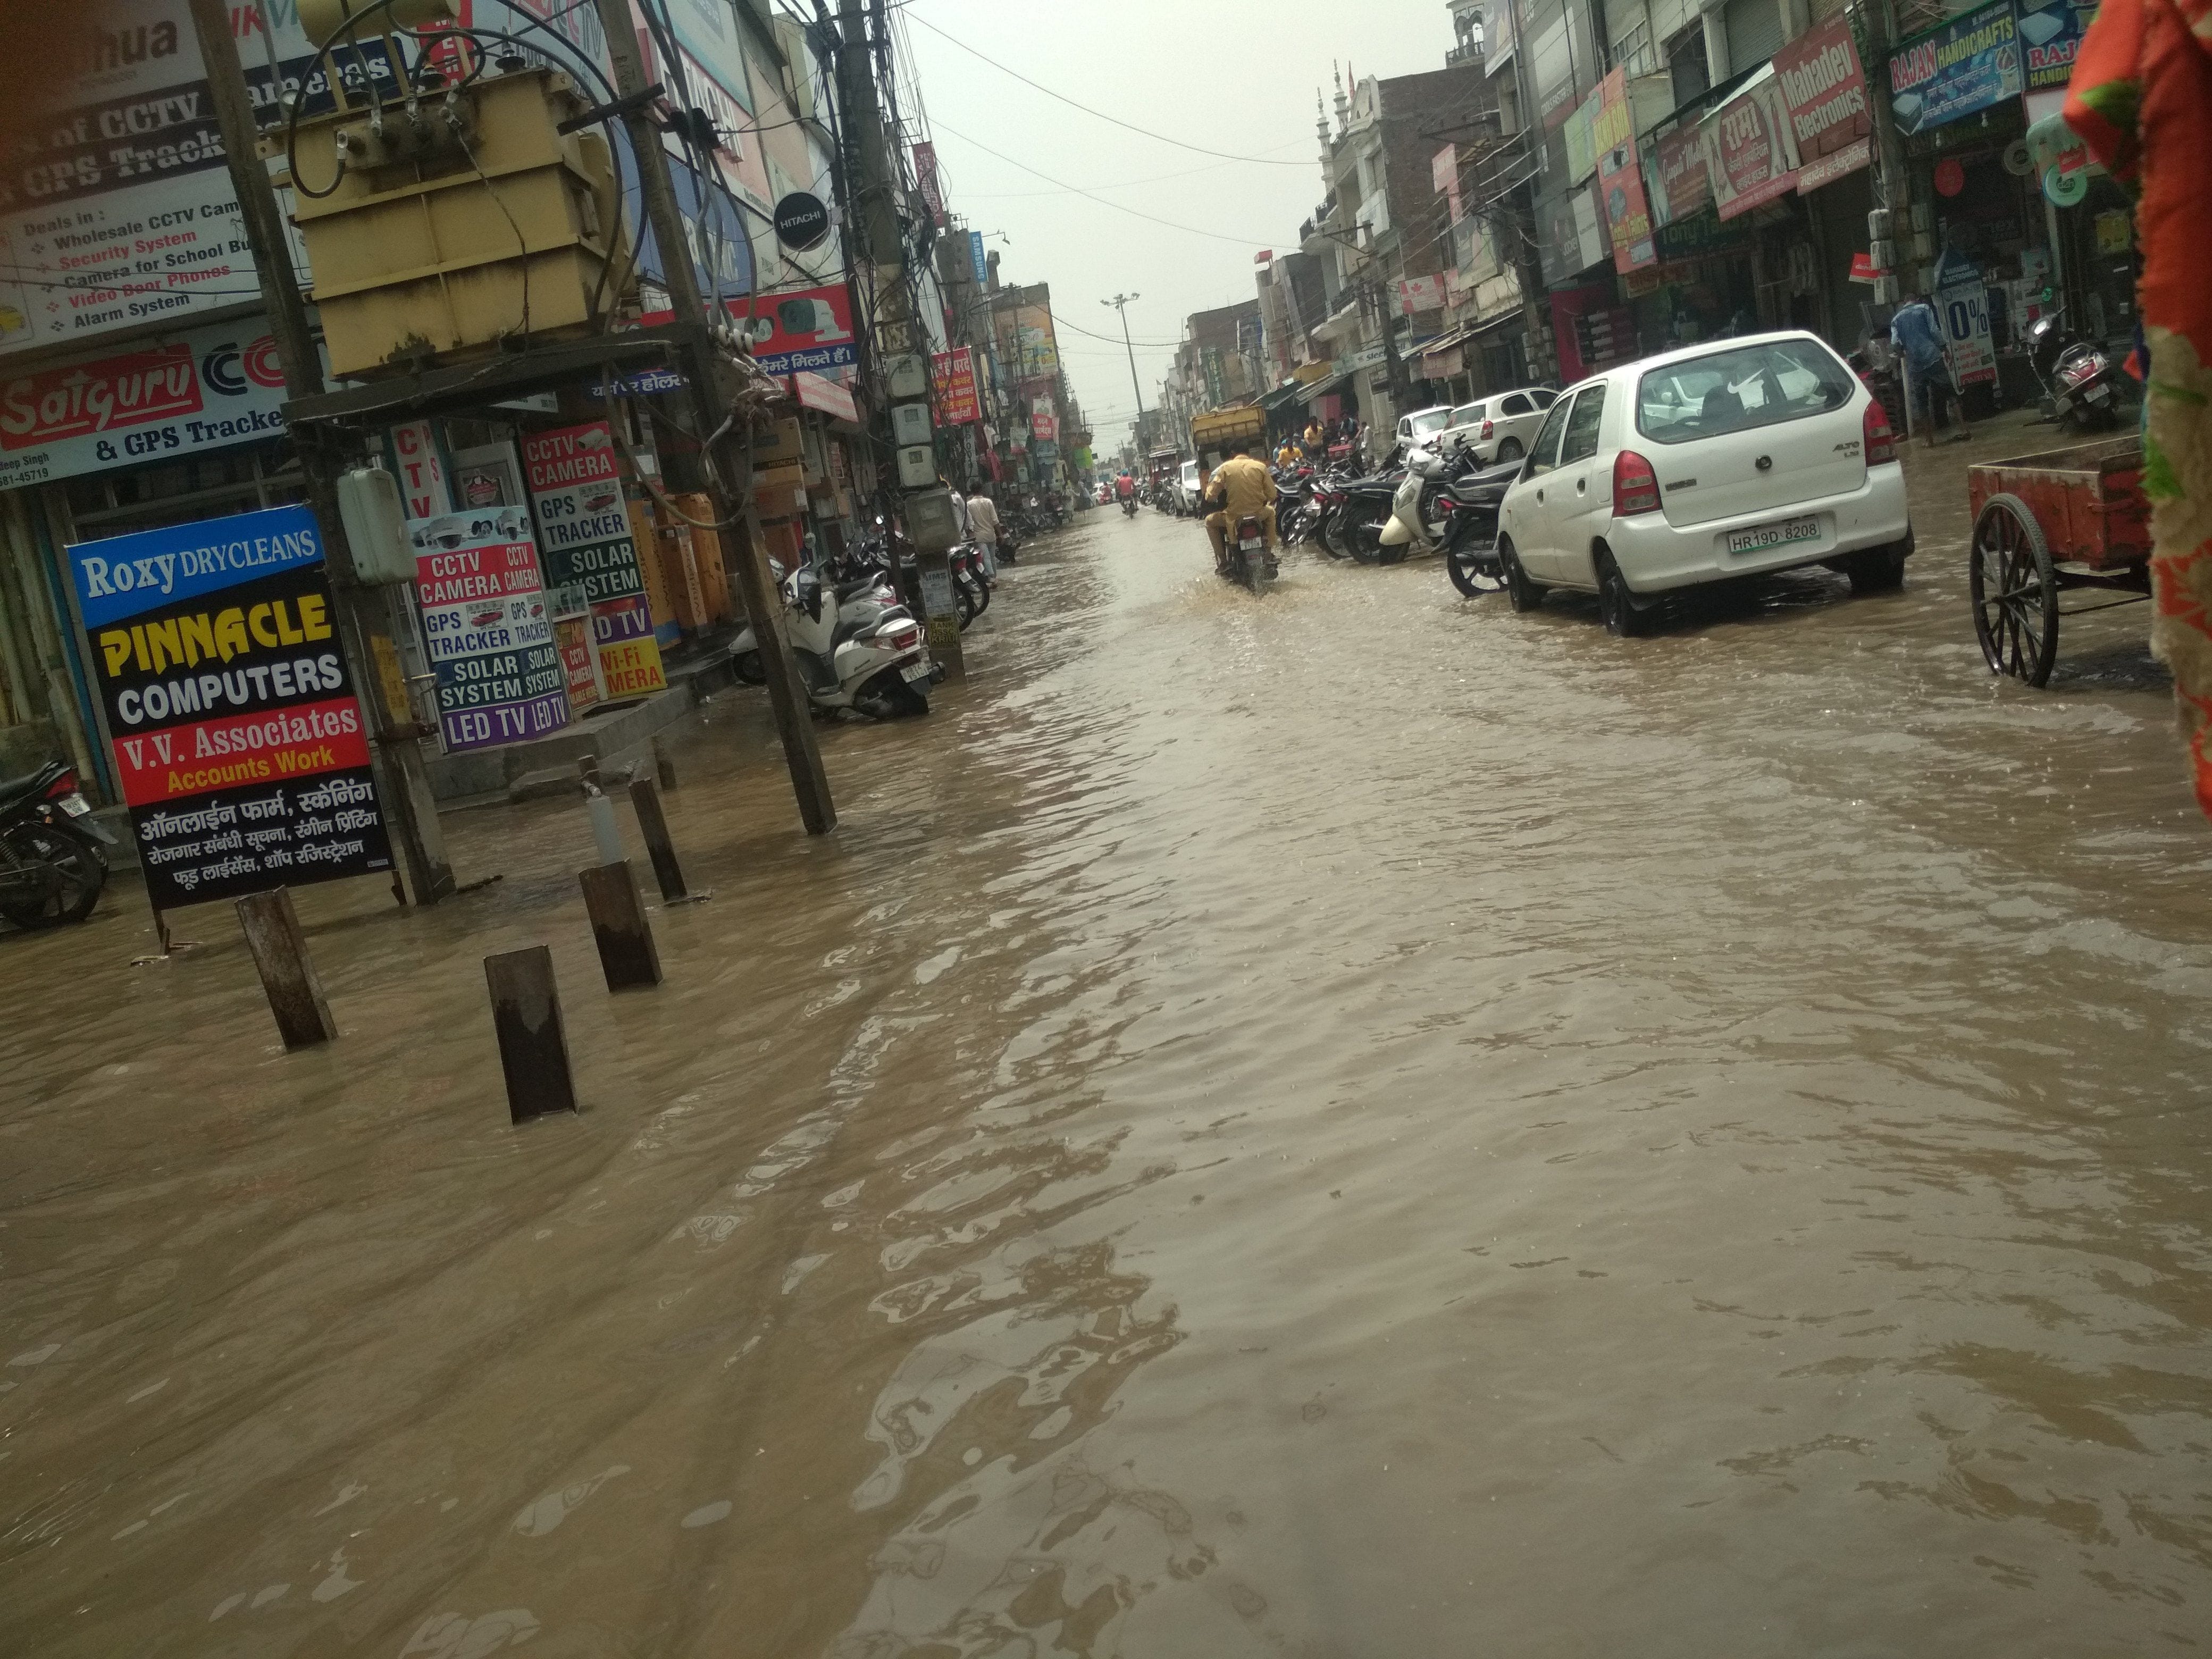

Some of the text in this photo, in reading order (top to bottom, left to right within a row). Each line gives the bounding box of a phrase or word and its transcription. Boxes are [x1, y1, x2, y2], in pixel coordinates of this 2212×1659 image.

[1890, 39, 1938, 94] RAJAN
[1937, 16, 2013, 69] HANDICRAFTS
[2027, 38, 2076, 70] RAJ
[1780, 40, 1854, 111] Mahadev
[99, 91, 199, 139] CCTV
[246, 57, 390, 107] ameras
[1722, 101, 1762, 151] रामा
[1794, 86, 1865, 143] Electronics
[23, 155, 102, 198] GPS
[109, 129, 225, 178] Track
[1800, 164, 1825, 187] महादेव
[24, 211, 93, 237] Deals in
[54, 201, 240, 250] Wholesale CCTV Cam
[780, 211, 821, 229] HITACHI
[59, 230, 196, 271] Security System
[64, 239, 249, 289] Camera for School Bu
[972, 236, 985, 280] SAMSUNG
[69, 265, 231, 308] Video Door Phones
[74, 293, 190, 328] Alarm System
[1948, 297, 1988, 340] 0%
[203, 334, 286, 396] CC
[791, 350, 830, 368] मिलते
[2, 364, 191, 435] Satguru
[96, 409, 283, 461] & GPS Tracke
[527, 436, 575, 462] CCTV
[1832, 441, 1859, 451] ALTO
[23, 453, 49, 465] Singh
[531, 454, 613, 486] CAMERA
[541, 496, 576, 519] GPS
[546, 514, 624, 547] TRACKER
[1785, 524, 1817, 539] 8208
[81, 530, 316, 598] Roxy DRYCLEANS
[431, 552, 481, 579] CCTV
[505, 546, 529, 567] CCTV
[571, 544, 633, 574] SOLAR
[420, 573, 502, 605] CAMERA
[504, 568, 540, 591] CAMERA
[426, 611, 461, 633] GPS
[510, 601, 527, 620] GPS
[617, 608, 646, 634] TV
[100, 593, 331, 678] PINNACLE
[430, 629, 510, 657] TRACKER
[515, 621, 550, 644] TRACKER
[454, 656, 518, 682] SOLAR
[527, 647, 556, 671] SOLAR
[569, 647, 585, 666] CCTV
[119, 653, 342, 724] COMPUTERS
[525, 669, 559, 695] SYSTEM
[569, 665, 594, 686] CAMERA
[606, 666, 661, 693] MERA
[441, 678, 523, 708] SYSTEM
[447, 707, 525, 745] LED TV
[533, 695, 566, 731] LED TV
[123, 708, 357, 770] V.V. Associates
[168, 745, 335, 793] Accounts Work
[140, 800, 237, 842] ऑनलाईन
[297, 778, 373, 812] स्केनिंग
[147, 840, 201, 866] रोजगार
[202, 831, 243, 854] संबंधी
[294, 814, 333, 840] रंगीन
[173, 868, 199, 891] फूड
[264, 848, 293, 869] शॉप
[295, 839, 364, 864] रजिस्ट्रेशन
